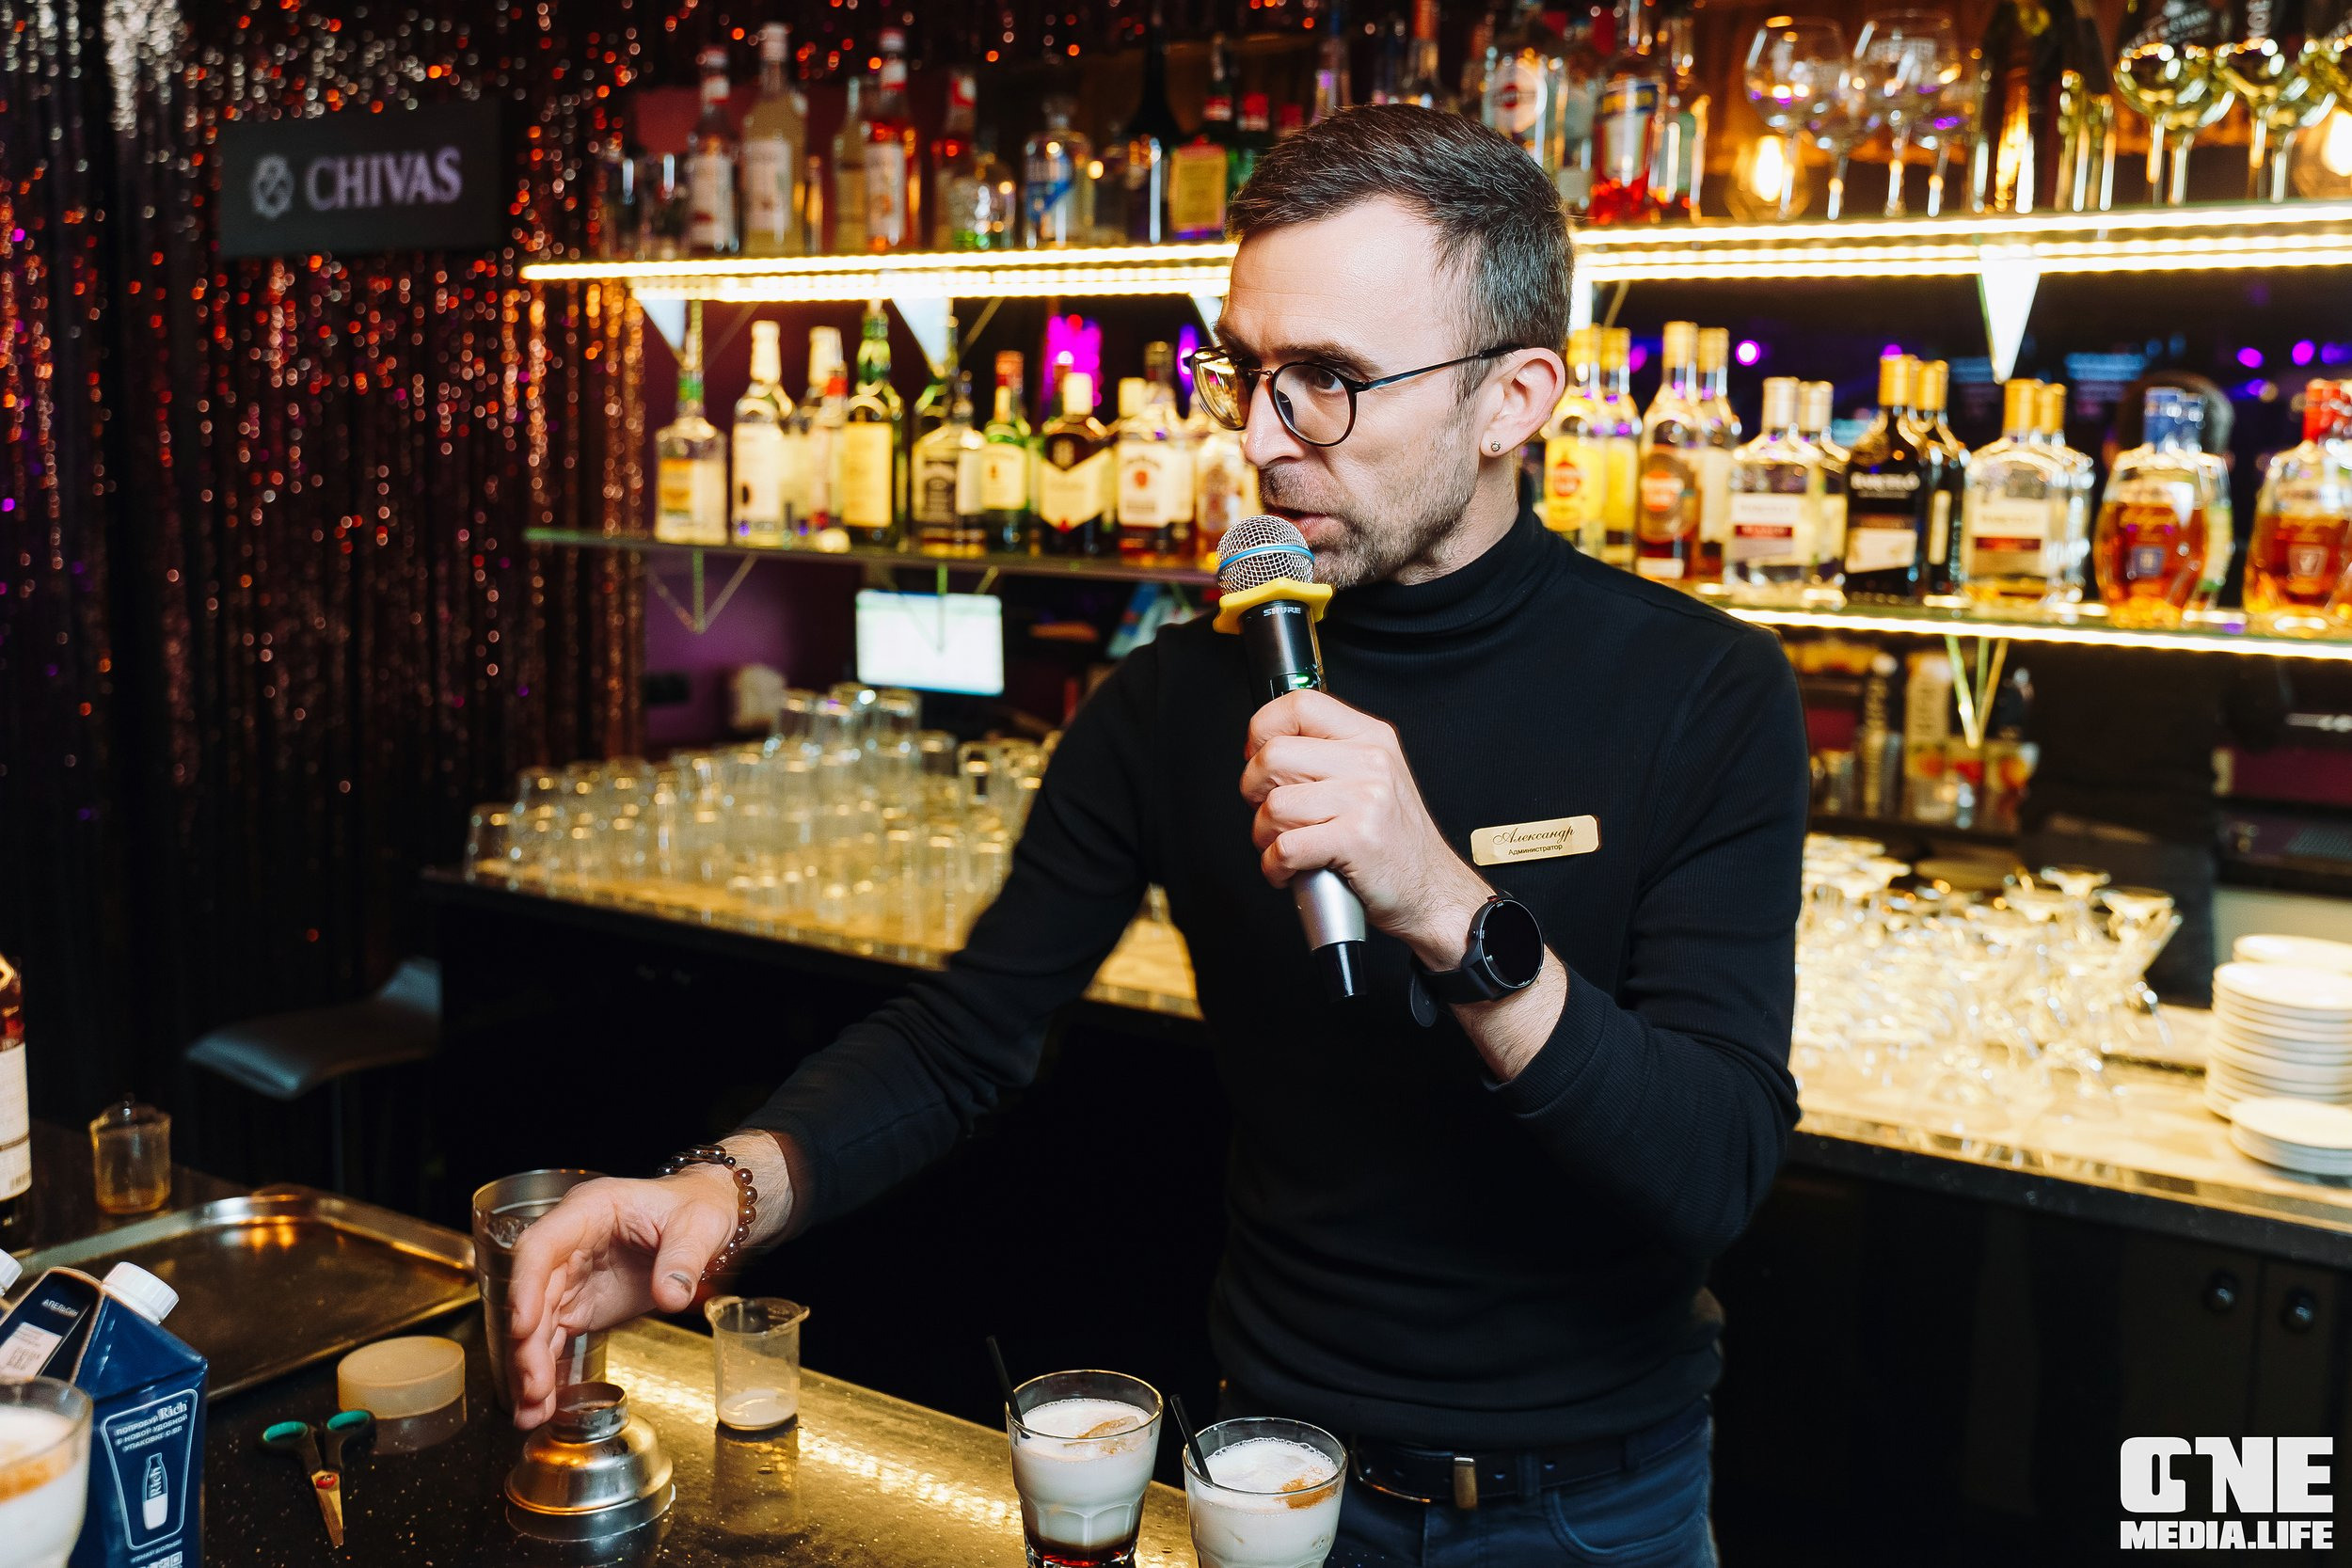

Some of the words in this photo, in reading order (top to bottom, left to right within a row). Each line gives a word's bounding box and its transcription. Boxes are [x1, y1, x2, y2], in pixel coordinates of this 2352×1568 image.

[305, 146, 462, 210] CHIVAS
[1263, 607, 1301, 616] SHURE
[1492, 825, 1575, 845] Александр
[1508, 844, 1563, 855] Администратор
[41, 1299, 79, 1317] АПЕЛЬСИН
[115, 1416, 159, 1435] ПОПРОБУЙ
[157, 1402, 187, 1421] Rich
[152, 1414, 187, 1433] УДОБНОЙ
[122, 1433, 165, 1451] УПАКОВКЕ
[149, 1466, 162, 1498] Rich
